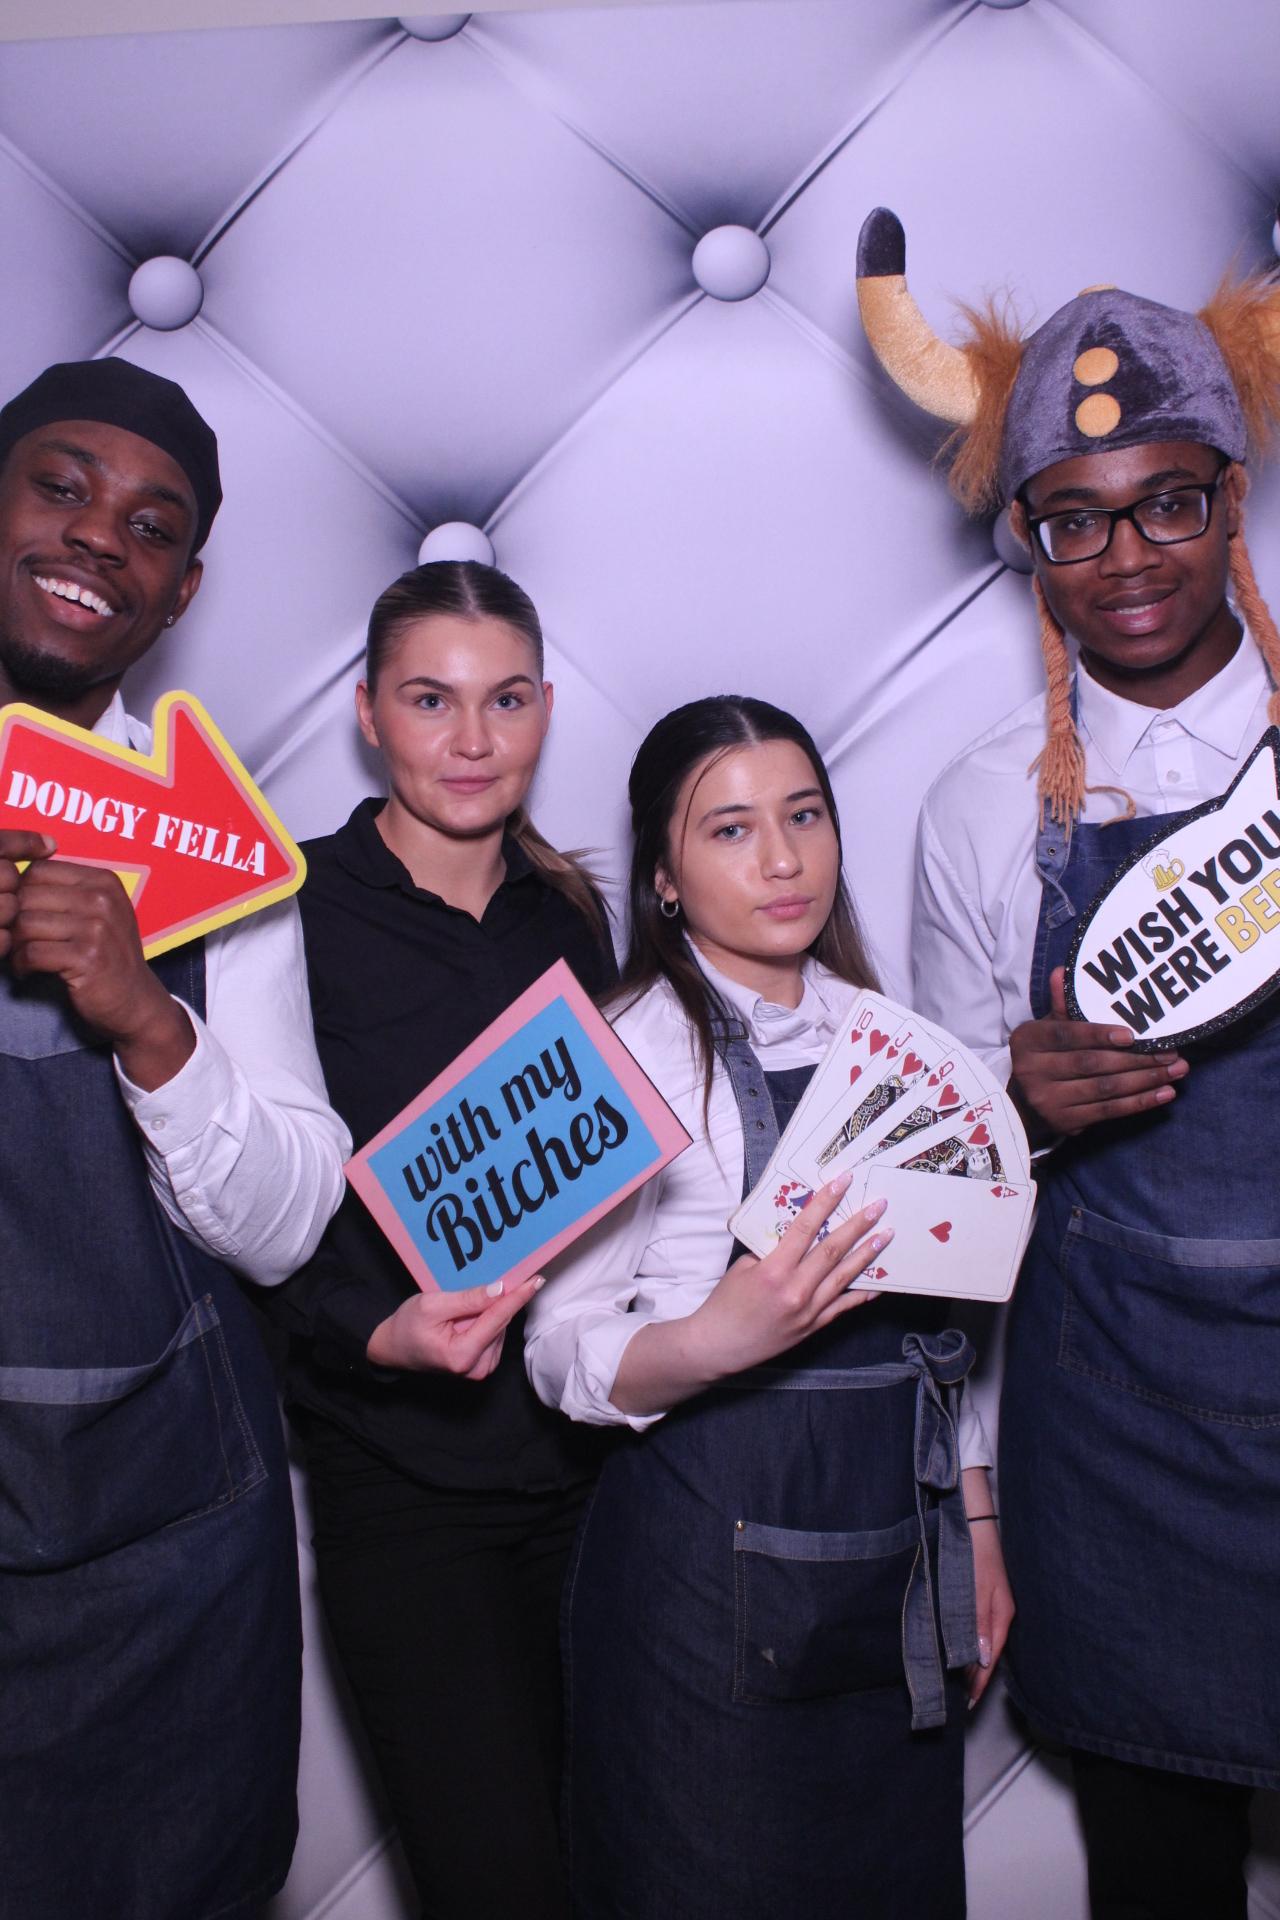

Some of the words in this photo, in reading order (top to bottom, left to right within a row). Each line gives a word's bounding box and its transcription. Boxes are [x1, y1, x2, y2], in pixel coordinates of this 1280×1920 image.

[5, 771, 146, 839] DODGY
[151, 813, 265, 876] FELLA
[1082, 886, 1204, 995] WISH
[1187, 809, 1280, 905] YOU
[1110, 928, 1232, 1035] WERE
[856, 1007, 874, 1031] 10
[894, 1031, 913, 1049] J
[938, 1060, 955, 1081] Q
[402, 1097, 502, 1203] with
[500, 1036, 582, 1125] my
[974, 1099, 993, 1120] K
[425, 1094, 629, 1272] Bitches
[1002, 1185, 1020, 1199] A
